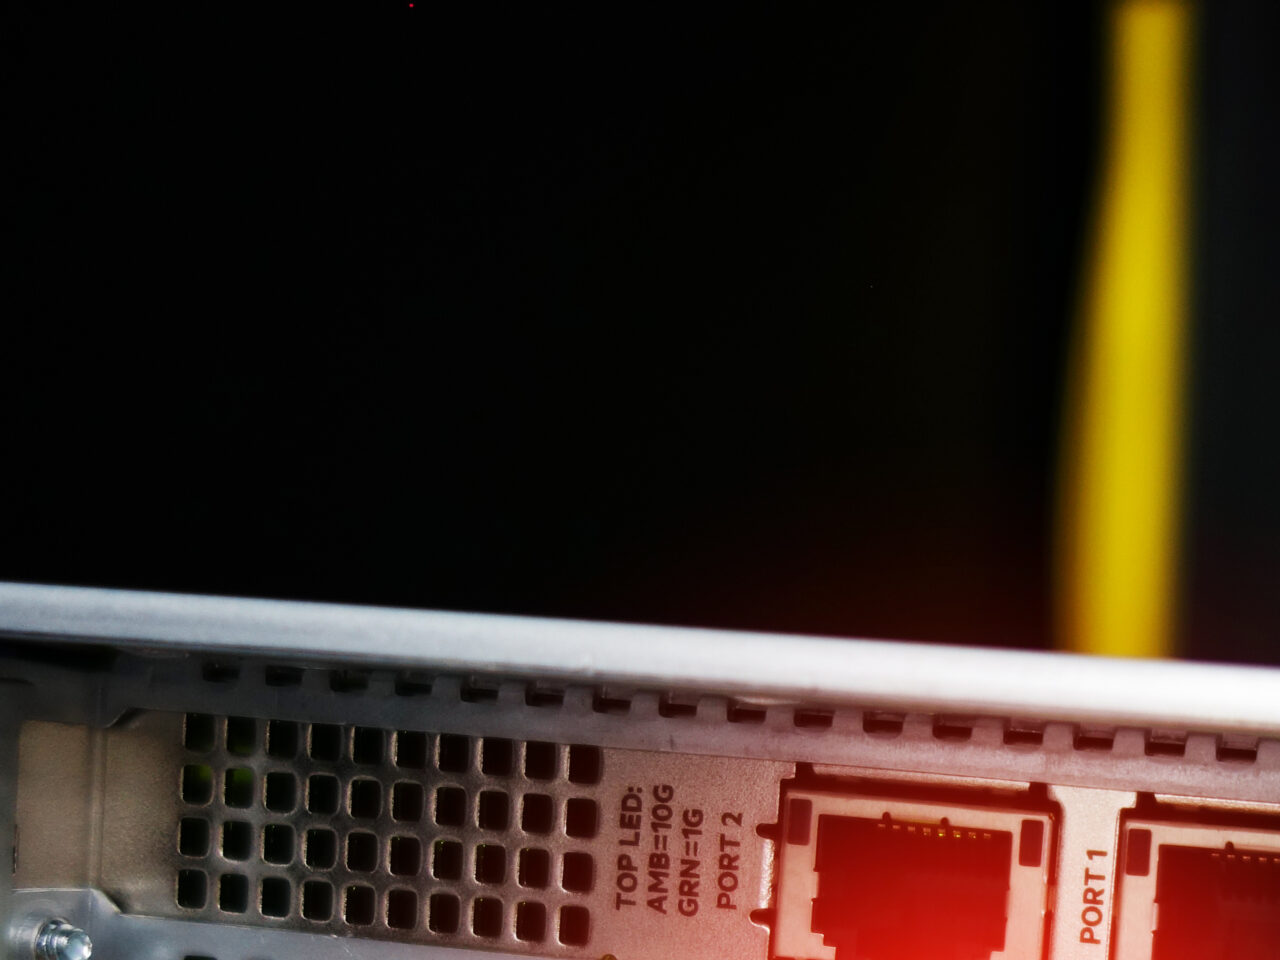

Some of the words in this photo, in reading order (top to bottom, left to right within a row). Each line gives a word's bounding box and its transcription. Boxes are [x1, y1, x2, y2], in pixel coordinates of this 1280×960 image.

[619, 786, 643, 846] LED:
[646, 784, 674, 915] AMB=10G
[721, 812, 743, 827] 2
[616, 854, 638, 911] TOP
[678, 808, 704, 917] GRN=1G
[716, 833, 740, 910] PORT
[1086, 849, 1108, 860] 1
[1079, 867, 1106, 945] PORT
